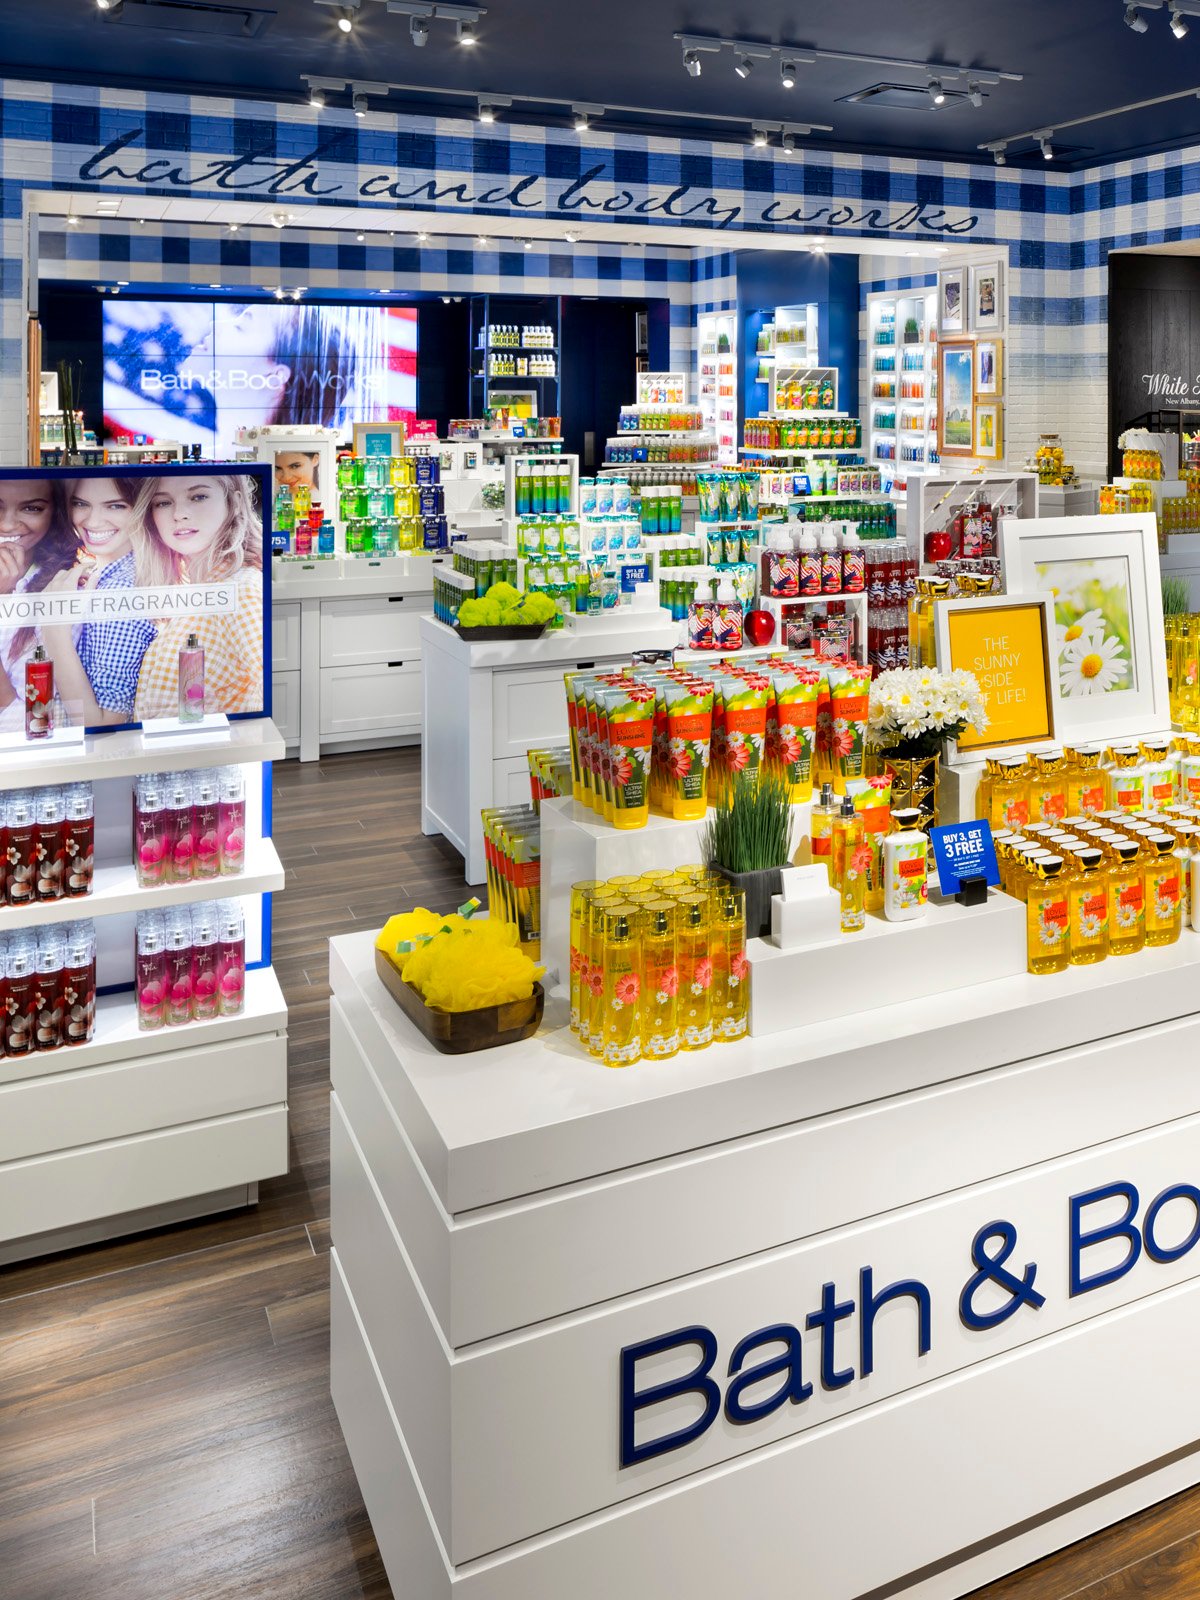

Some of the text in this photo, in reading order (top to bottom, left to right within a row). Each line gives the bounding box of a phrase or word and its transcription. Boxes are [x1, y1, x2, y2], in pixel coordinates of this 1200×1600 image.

[79, 128, 979, 234] bath and body works
[1141, 373, 1189, 395] White
[1180, 398, 1200, 406] Albany,
[90, 590, 229, 613] FRAGRANCES
[983, 636, 1009, 652] THE
[974, 653, 1021, 671] SUNNY
[984, 671, 1013, 689] SIDE
[997, 688, 1026, 705] LIFE!
[942, 829, 981, 844] BUY 3, GET
[945, 844, 954, 858] 3
[954, 839, 984, 856] FREE
[618, 1264, 931, 1469] Bath
[957, 1219, 1046, 1332] &
